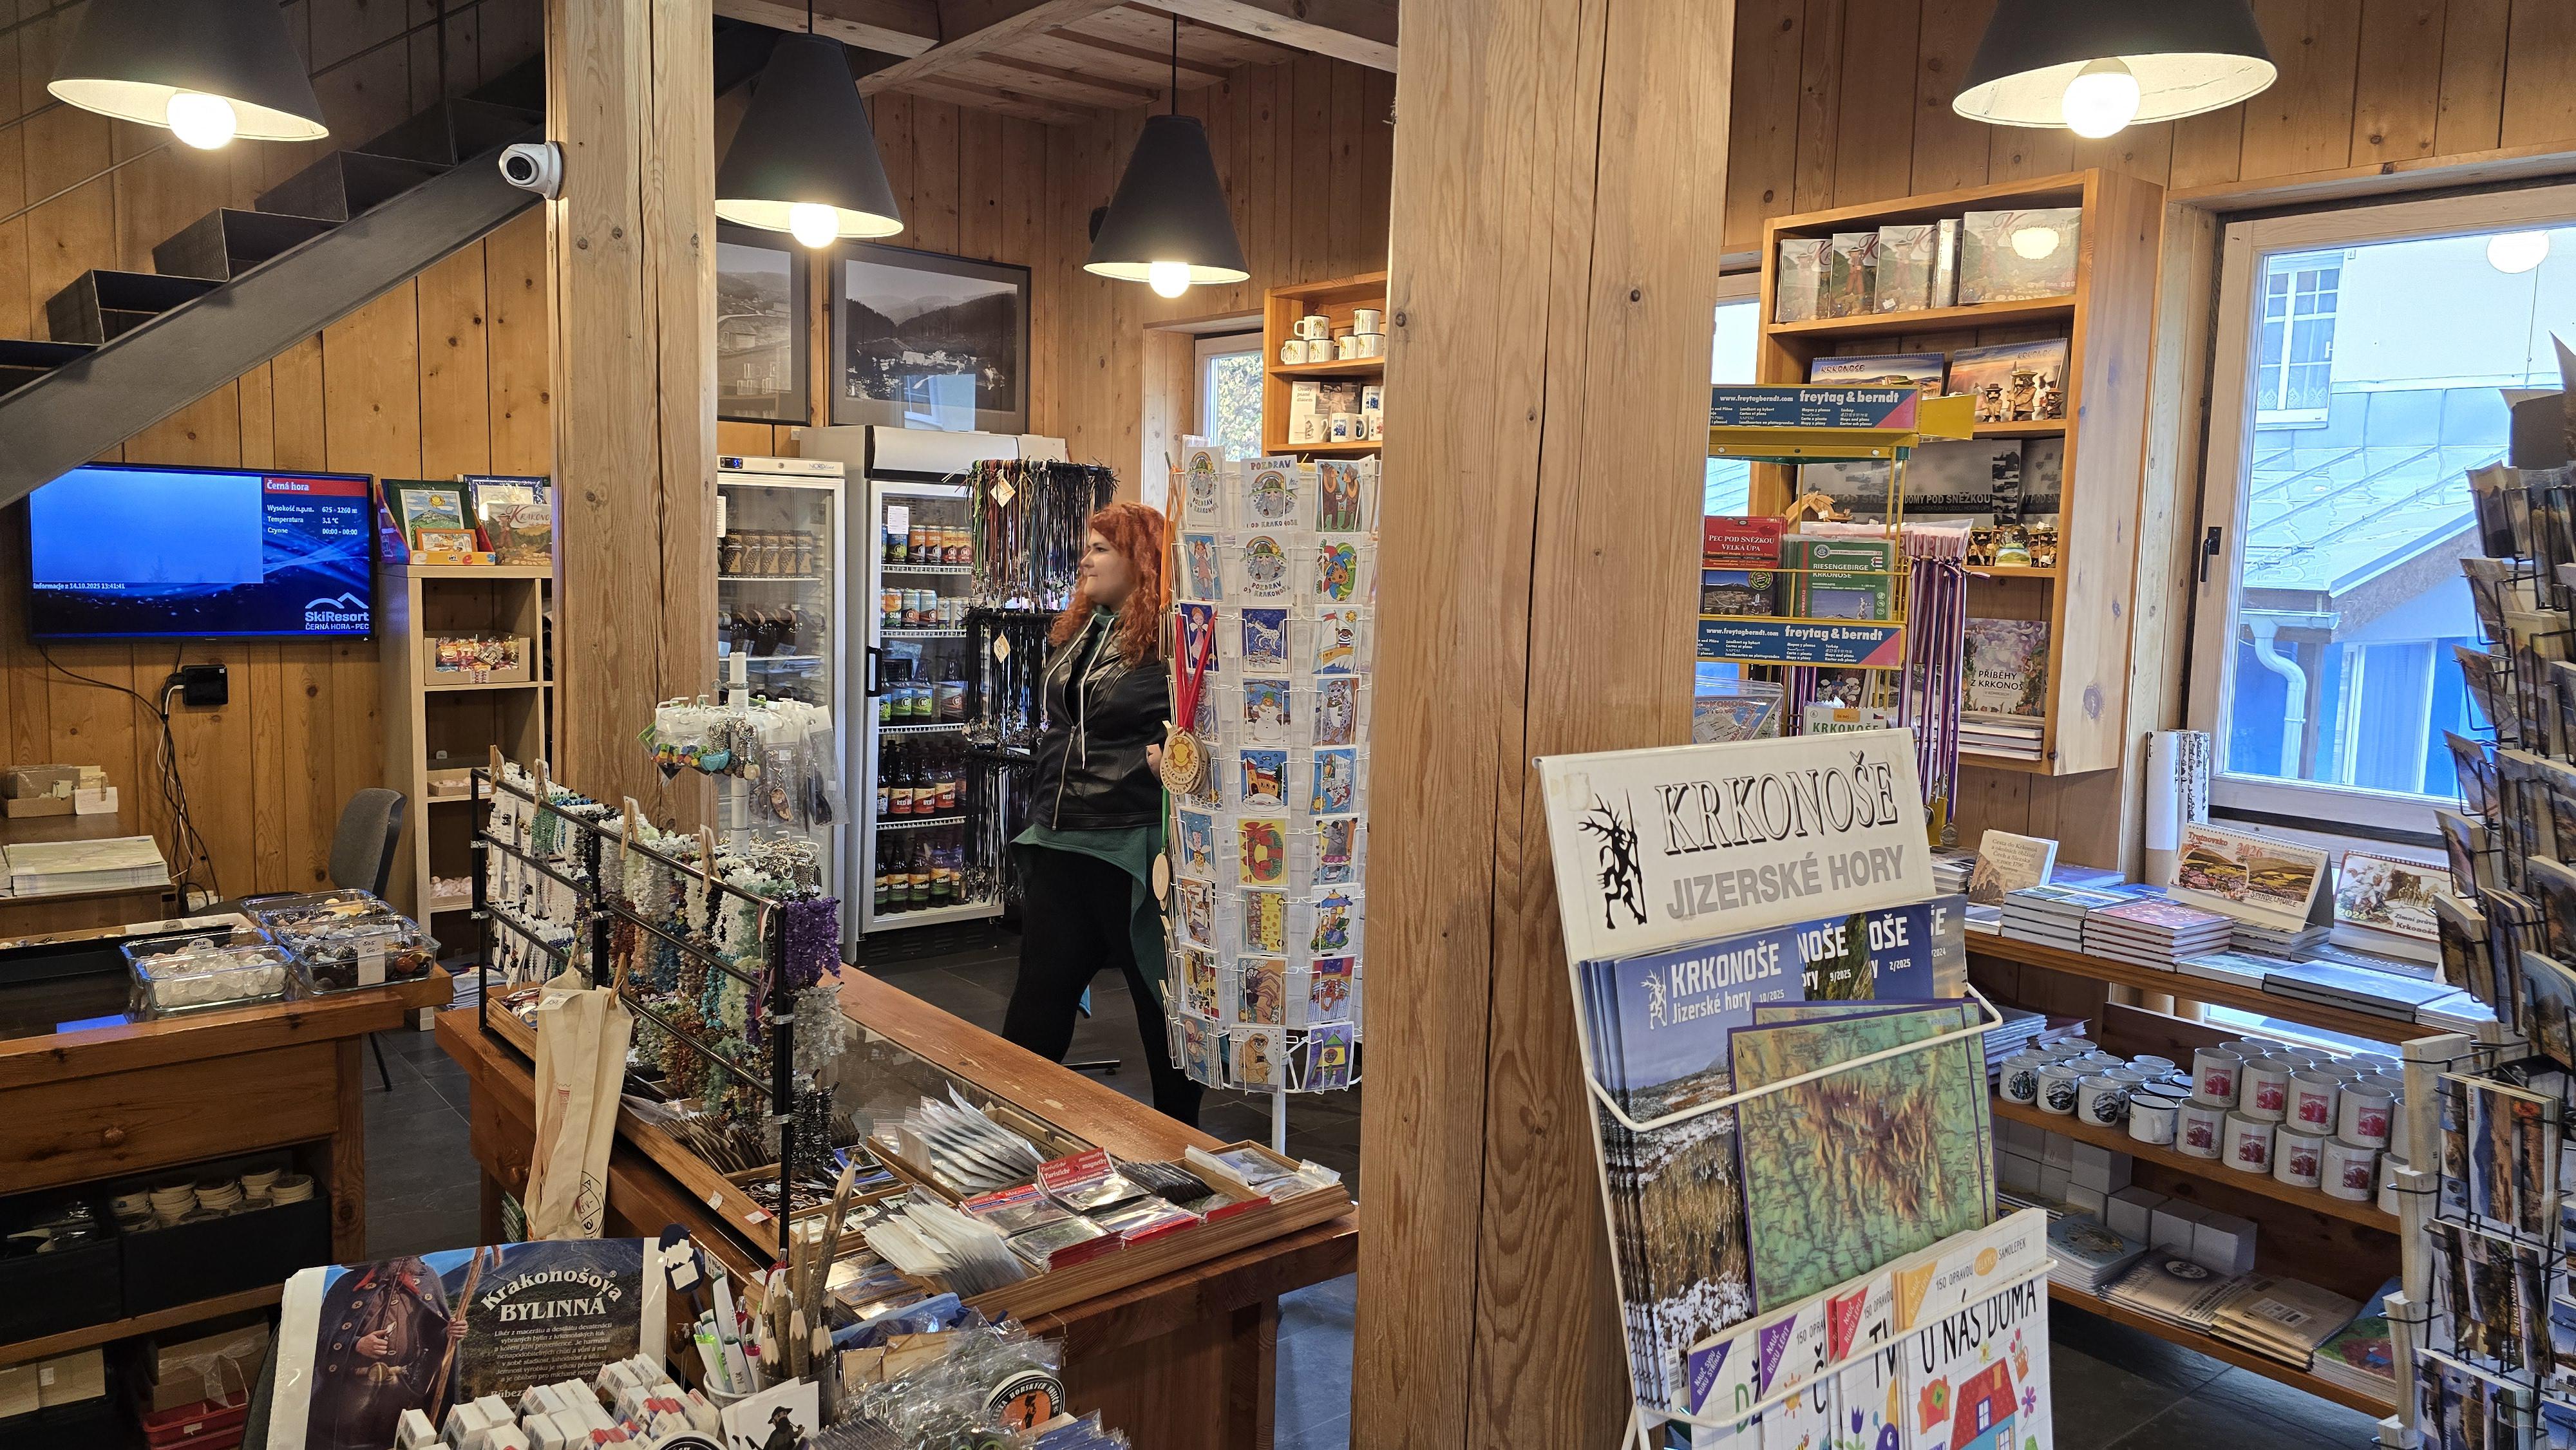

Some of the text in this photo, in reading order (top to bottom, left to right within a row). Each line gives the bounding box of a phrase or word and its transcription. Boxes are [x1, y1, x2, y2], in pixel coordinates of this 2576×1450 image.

[1820, 363, 1865, 374] KRKONOŠE
[1720, 395, 1794, 403] www.freytagberndt.com
[1800, 390, 1899, 406] freytag & berndt
[1251, 460, 1291, 471] POZDRAV
[267, 479, 309, 491] Černá hora
[1193, 498, 1213, 507] POZDRAV
[1904, 491, 1991, 504] DOMY POD SNĚŽKOU
[1741, 536, 1775, 544] SNĚŽKOU
[33, 582, 64, 590] Informacje
[1252, 581, 1282, 591] POZDRAV
[305, 611, 370, 622] SkiResort
[1707, 628, 1779, 636] www.freytagberndt.com
[1785, 625, 1883, 641] freytag & berndt
[1978, 669, 2018, 680] PŘÍBĚHY
[1978, 680, 2023, 690] KRKONOŠ
[1813, 722, 1879, 733] KRKONOŠE
[1654, 750, 1899, 855] KRKONOŠE
[2188, 831, 2228, 847] Trutnovsko
[2235, 842, 2263, 858] 2026
[1666, 844, 1904, 919] JIZERSKÉ HORY
[2338, 908, 2368, 920] 2026
[2394, 913, 2416, 922] Zimní
[1869, 910, 1910, 952] OŠE
[1672, 940, 1783, 998] KRKONOŠE
[1889, 958, 1911, 971] 2/2025
[1830, 968, 1852, 983] 9/2025
[1672, 989, 1785, 1025] Jizerské hory 10/2025
[1044, 1158, 1108, 1180] Turistické magnetky
[1936, 1277, 1947, 1291] 150
[1949, 1263, 1973, 1286] OPRAVDU
[1998, 1237, 2026, 1261] SAMOLEPEK
[480, 1267, 622, 1311] Krakonošova
[500, 1290, 607, 1322] BYLINNÁ
[1910, 1293, 1921, 1315] RUKU
[1843, 1301, 1855, 1324] NAUČ
[1864, 1308, 1873, 1319] 150
[578, 1322, 612, 1330] devatenácti
[1844, 1296, 1864, 1344] RUKU LEPIT
[1942, 1288, 1982, 1364] NÁS
[1987, 1279, 2037, 1339] DOMA
[501, 1335, 531, 1344] vybraných
[554, 1330, 594, 1340] krkonošských
[1766, 1330, 1780, 1353] NAUČ
[1796, 1332, 1807, 1346] 150
[497, 1350, 556, 1359] nenapodobitelných
[1766, 1325, 1790, 1374] RUKU LEPIT
[524, 1365, 548, 1373] výrobku
[551, 1370, 576, 1379] míchané
[1694, 1366, 1707, 1386] NAUČ
[1696, 1377, 1710, 1395] RUKU
[991, 1400, 1009, 1422] CESTA
[1009, 1382, 1047, 1399] HORSKÝCH
